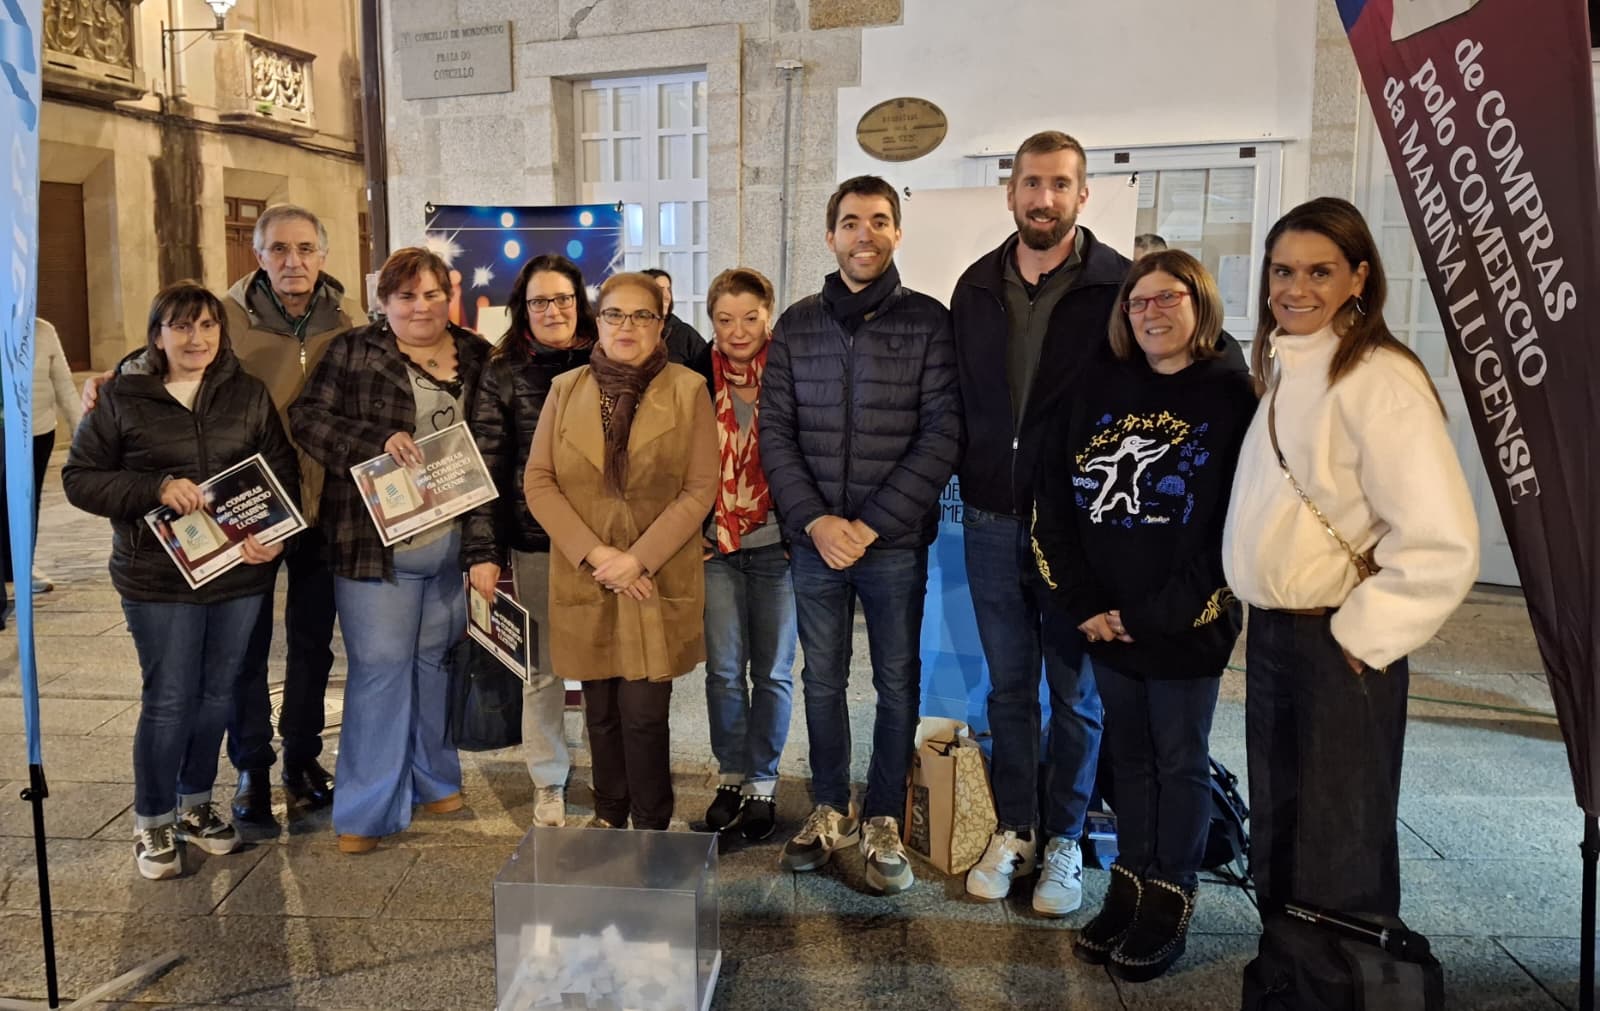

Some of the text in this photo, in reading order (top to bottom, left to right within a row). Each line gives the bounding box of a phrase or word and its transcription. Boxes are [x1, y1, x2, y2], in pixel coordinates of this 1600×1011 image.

[1383, 76, 1541, 505] da MARIÑA LUCENSE
[1410, 58, 1548, 387] polo COMERCIO
[1455, 38, 1577, 322] de COMPRAS
